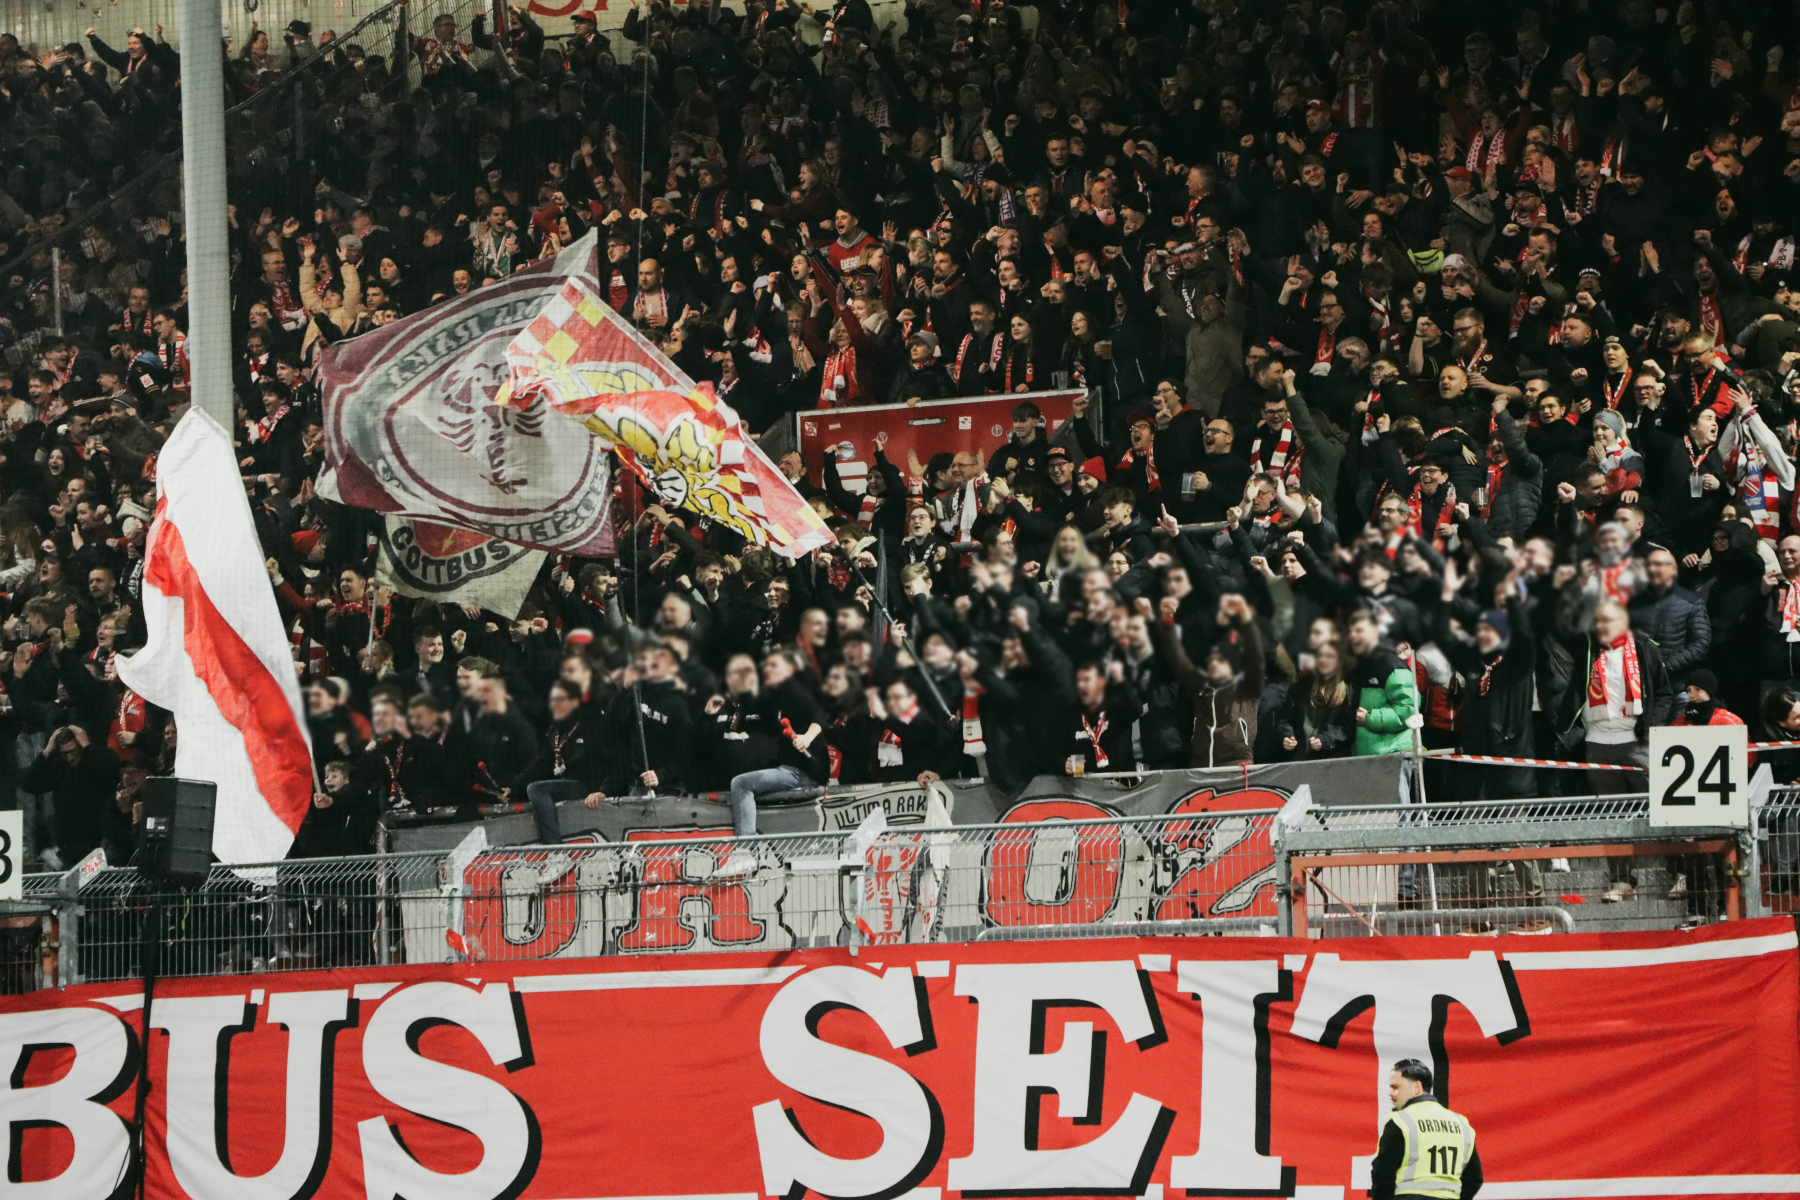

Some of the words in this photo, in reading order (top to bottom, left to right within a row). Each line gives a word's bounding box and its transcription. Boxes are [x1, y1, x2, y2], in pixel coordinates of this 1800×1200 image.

[391, 526, 511, 584] COTTBUS
[1661, 744, 1737, 807] 24
[834, 799, 891, 828] ULTIMA
[896, 795, 928, 814] RAK
[0, 981, 542, 1200] BUS
[752, 951, 1532, 1200] SEIT
[1417, 1119, 1462, 1135] ORDNER
[1427, 1145, 1458, 1176] 117
